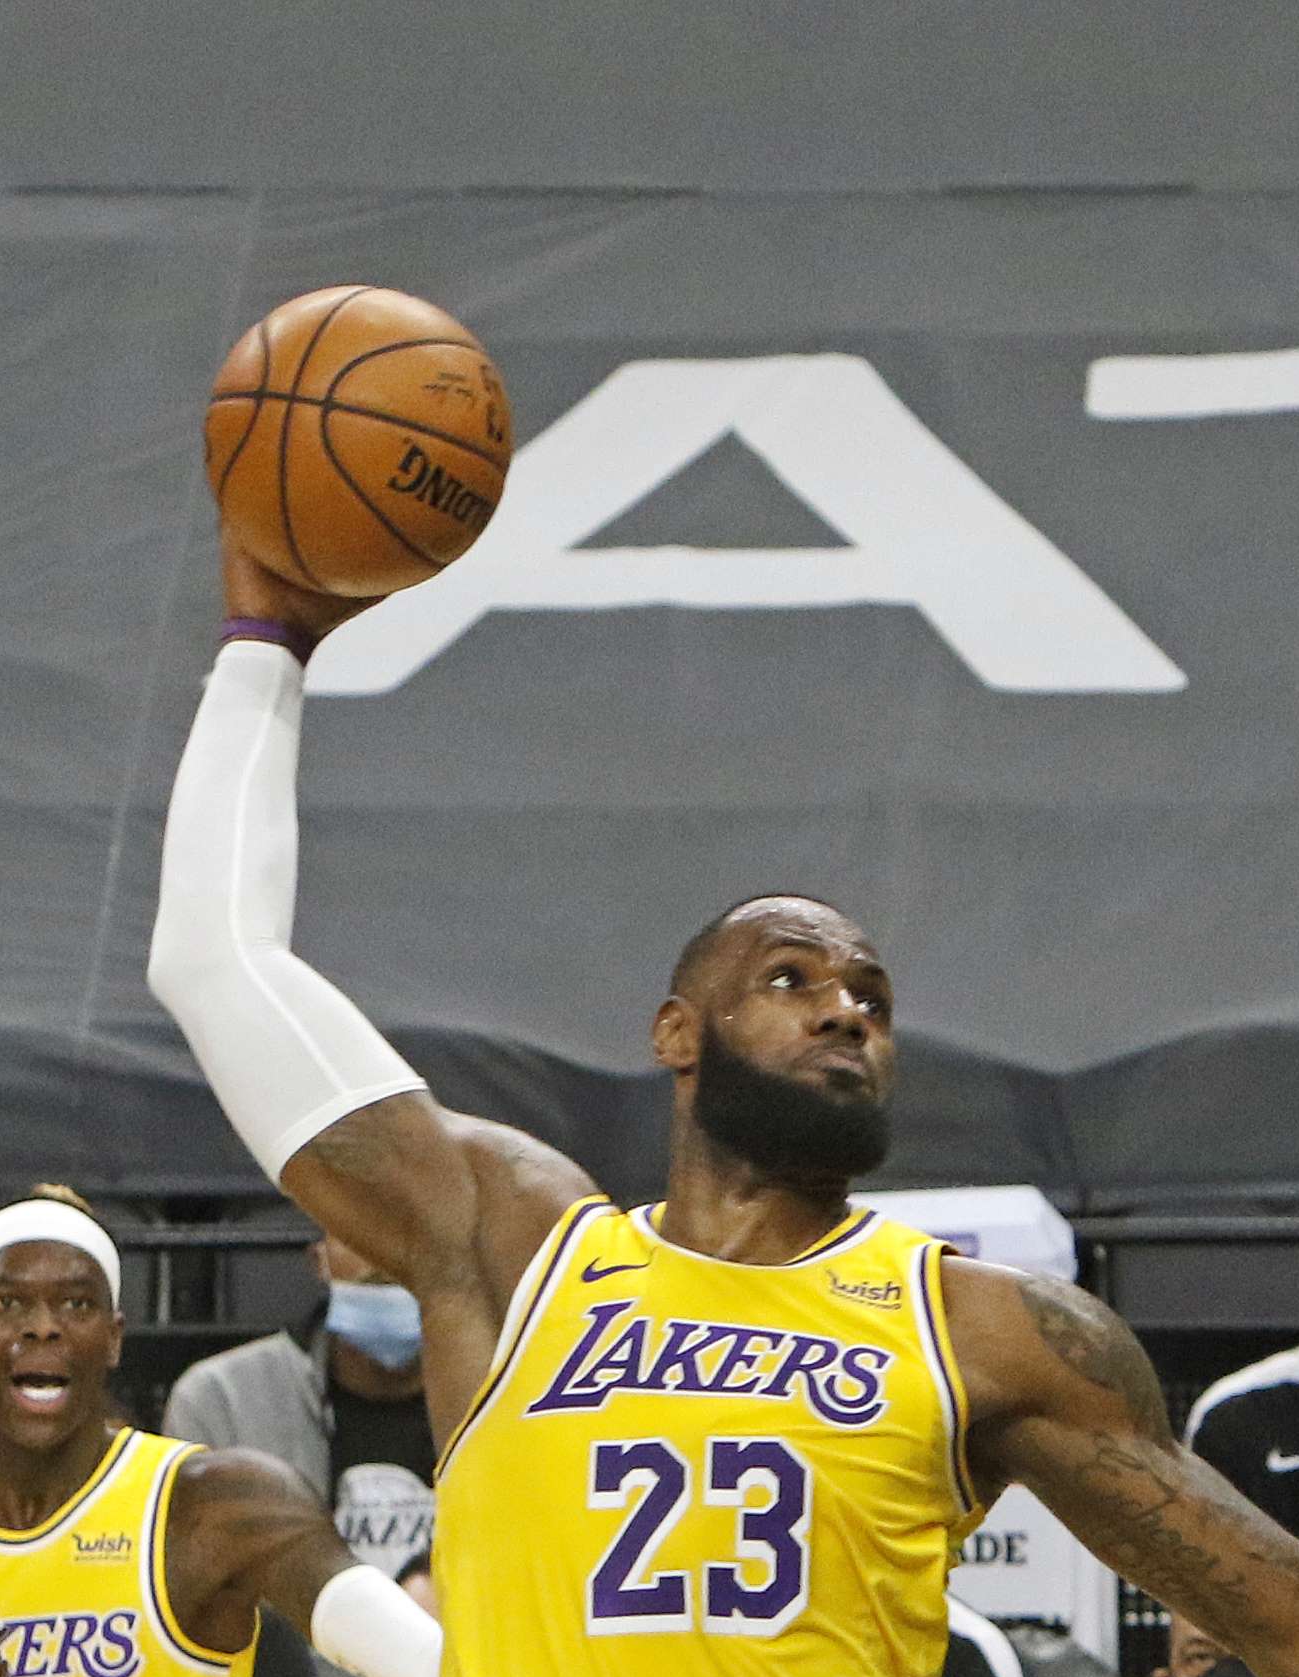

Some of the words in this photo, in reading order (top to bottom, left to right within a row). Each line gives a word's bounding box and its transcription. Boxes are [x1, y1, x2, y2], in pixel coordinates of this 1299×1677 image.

[826, 1268, 901, 1301] wish
[523, 1298, 896, 1428] LAKERS
[72, 1531, 132, 1552] wish
[586, 1436, 814, 1636] 23
